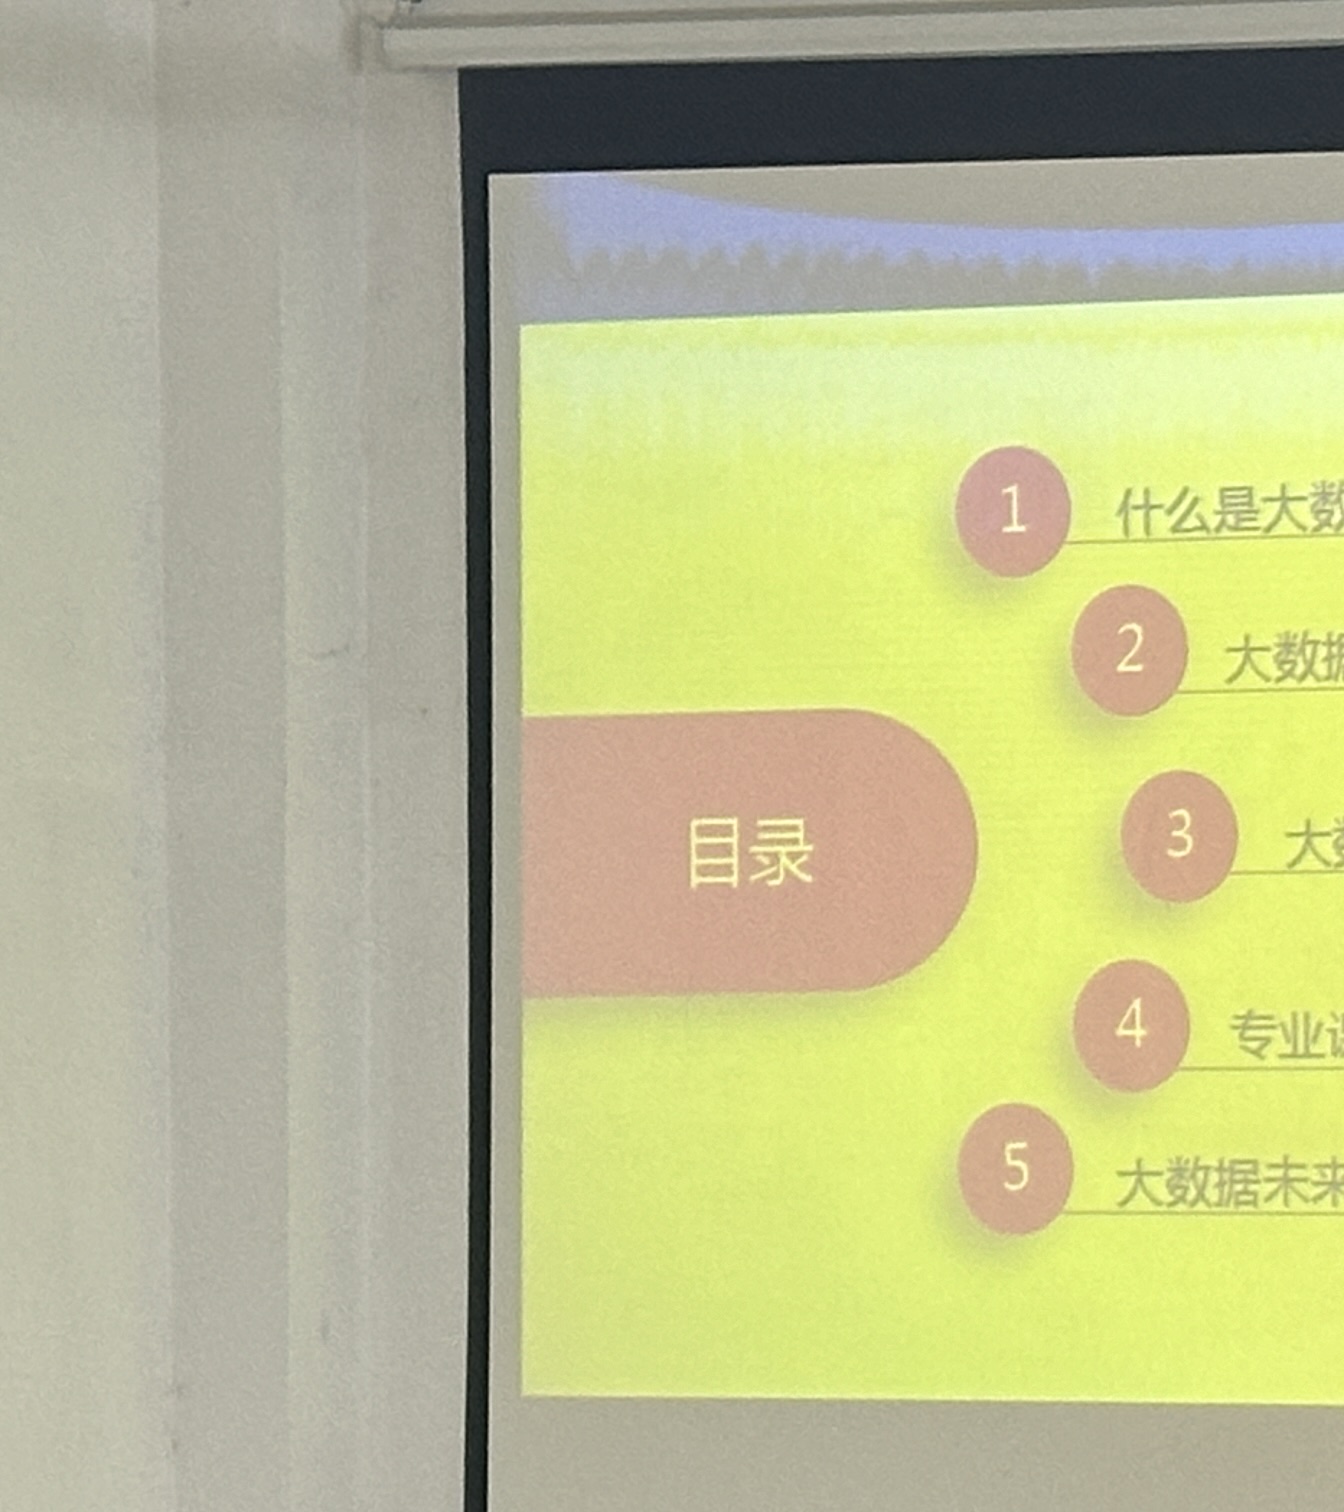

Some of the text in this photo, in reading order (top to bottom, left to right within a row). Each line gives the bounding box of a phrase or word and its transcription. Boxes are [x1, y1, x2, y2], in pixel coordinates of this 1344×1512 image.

[1001, 484, 1027, 533] 1
[1116, 622, 1144, 673] 2
[689, 816, 814, 889] 目录
[1166, 807, 1194, 859] 3
[1115, 997, 1148, 1048] 4
[1003, 1141, 1030, 1192] 5
